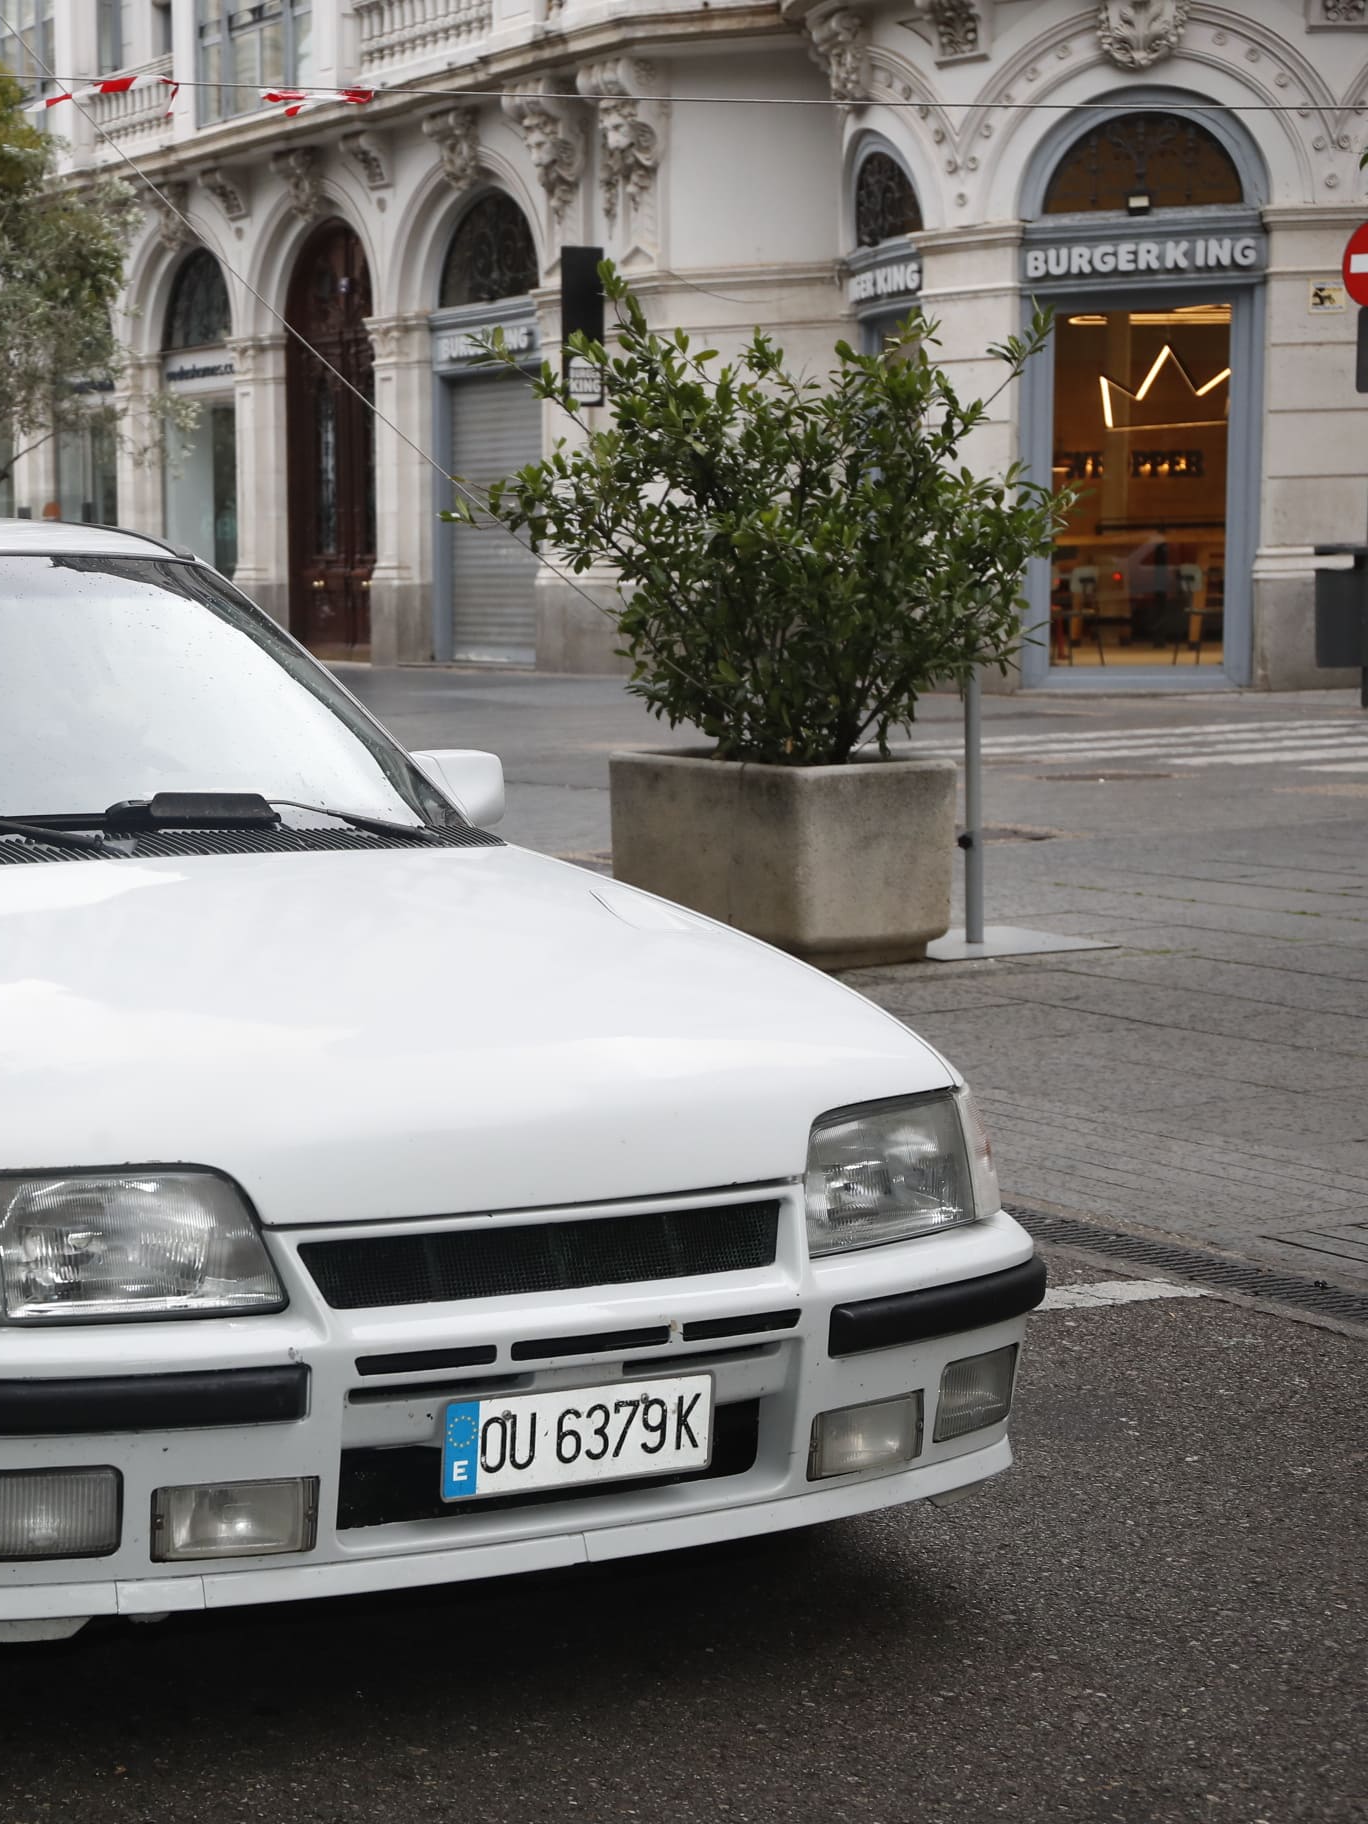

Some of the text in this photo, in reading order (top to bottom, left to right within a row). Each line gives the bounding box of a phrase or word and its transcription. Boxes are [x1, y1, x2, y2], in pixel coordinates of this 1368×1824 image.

[1026, 237, 1258, 278] BURGER KING
[876, 262, 921, 294] KING
[569, 378, 602, 393] KING
[1063, 450, 1206, 479] WHPPER
[452, 1459, 469, 1482] E
[480, 1411, 537, 1475] OU
